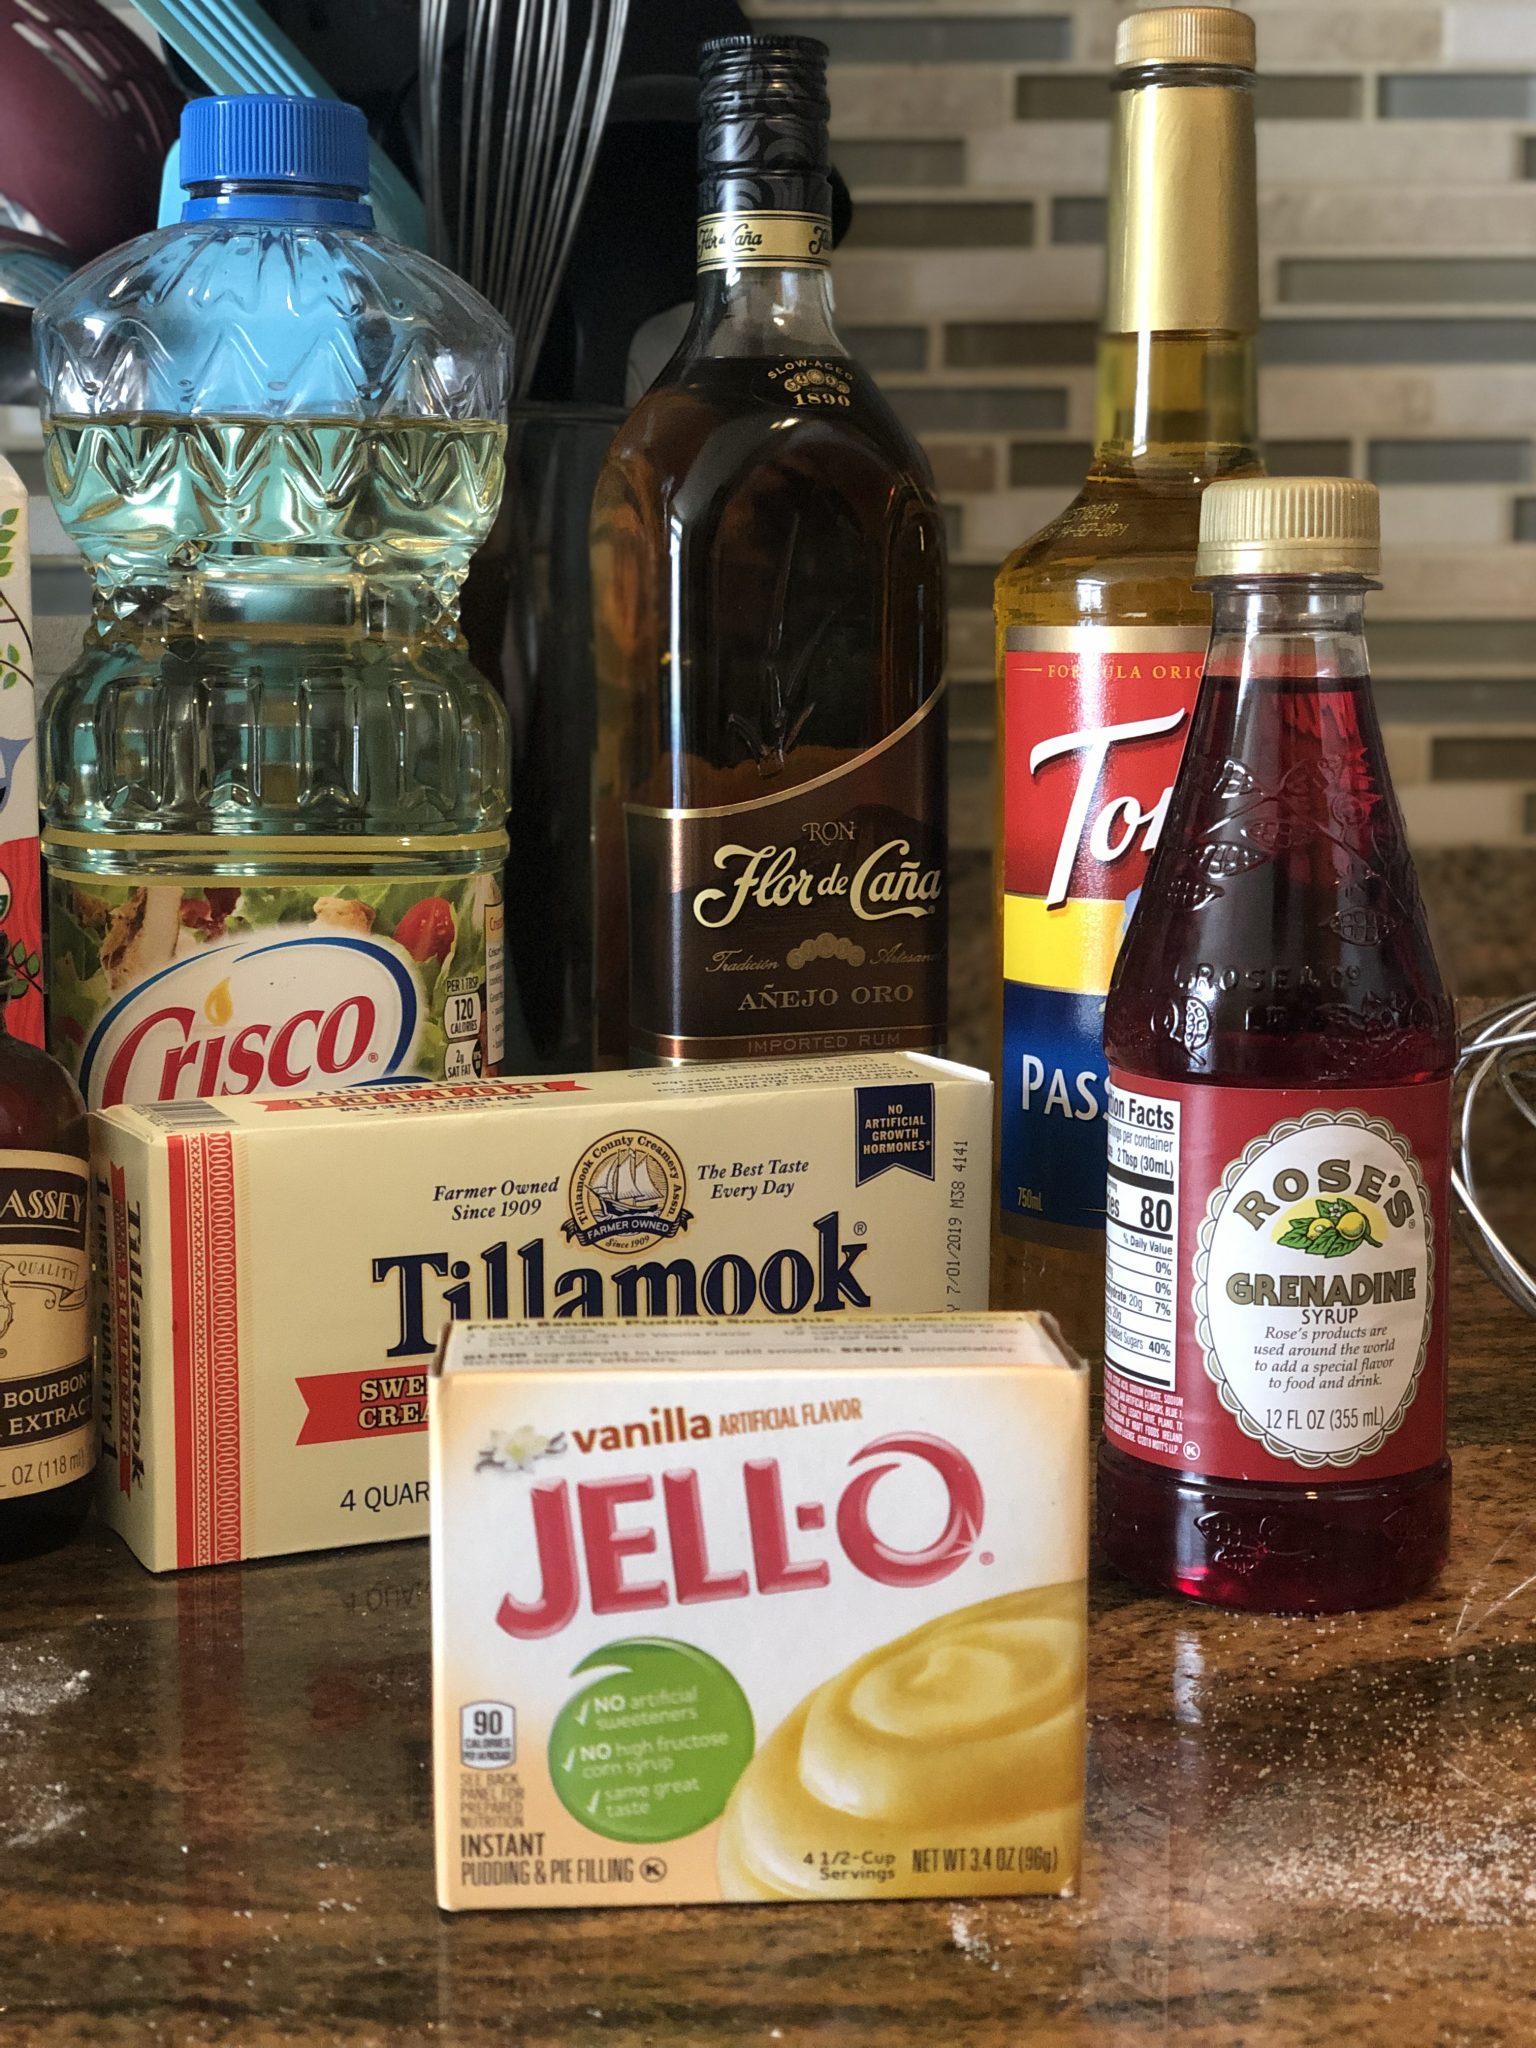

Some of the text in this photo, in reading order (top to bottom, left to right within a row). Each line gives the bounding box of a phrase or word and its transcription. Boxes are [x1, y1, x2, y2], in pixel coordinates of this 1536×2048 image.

[767, 360, 854, 381] SLOW-AGED
[793, 393, 851, 407] 1890
[802, 821, 856, 846] RON
[693, 839, 942, 928] Flor de Caña
[447, 980, 459, 992] PER
[737, 984, 914, 1011] AÑEJO ORO
[455, 997, 474, 1021] 120
[450, 1020, 478, 1035] CALORIES
[102, 995, 375, 1111] Crisco
[748, 1033, 902, 1054] IMPORTED RUM
[448, 1064, 472, 1079] SAT FAT
[1022, 1054, 1109, 1121] PAS
[888, 1104, 903, 1115] NO
[1129, 1097, 1175, 1131] Facts
[865, 1115, 927, 1129] ARTIFICIAL
[871, 1127, 920, 1141] GROWTH
[1134, 1132, 1173, 1153] container
[697, 1159, 809, 1180] The Best Taste
[1122, 1149, 1138, 1172] Tbsp
[1140, 1154, 1174, 1179] (30mL)
[592, 1134, 634, 1160] County
[637, 1135, 680, 1181] Creamery
[666, 1183, 682, 1218] Assn.
[432, 1176, 561, 1202] Farmer Owned
[710, 1179, 795, 1201] Every Day
[1233, 1159, 1415, 1231] ROSE'S
[451, 1198, 543, 1221] Since 1909
[945, 1140, 968, 1295] 7/01/2019 M38 4141
[1139, 1195, 1173, 1233] 80
[587, 1220, 670, 1240] FARMER OWNED
[605, 1235, 651, 1249] Since 1909
[1130, 1234, 1173, 1256] Daily Value
[17, 1260, 76, 1283] QUALITY
[1155, 1261, 1172, 1276] 0%
[372, 1211, 871, 1358] Tillamook
[1154, 1281, 1172, 1296] 0%
[1225, 1267, 1416, 1307] GRENADINE
[1155, 1301, 1171, 1317] 7%
[1301, 1308, 1359, 1325] SYRUP
[1264, 1325, 1388, 1343] Rose's products are
[1148, 1340, 1171, 1357] 40%
[1253, 1338, 1396, 1357] used around the world
[1254, 1357, 1395, 1376] to add a special flavor
[3, 1373, 87, 1409] BOURBON
[1268, 1374, 1383, 1393] to food and drink.
[571, 1397, 864, 1456] vanilla ARTIFICIAL FLAVOR
[1266, 1406, 1384, 1432] 12 FL OZ (355 mL)
[12, 1464, 33, 1486] OZ
[38, 1454, 68, 1486] (118
[339, 1489, 357, 1512] 4
[495, 1429, 985, 1641] JELL-O
[594, 1694, 626, 1714] NO
[473, 1709, 503, 1736] 90
[464, 1738, 512, 1750] CALORIES
[580, 1742, 613, 1762] NO
[604, 1800, 650, 1818] taste
[461, 1832, 546, 1858] INSTANT
[803, 1851, 896, 1867] 4 1/2-Cup
[912, 1847, 938, 1873] NET
[942, 1847, 967, 1872] WT
[969, 1846, 991, 1872] 3.4
[995, 1845, 1016, 1871] OZ
[461, 1856, 634, 1886] PUDDING & PIE FILLING
[819, 1866, 896, 1884] Servings
